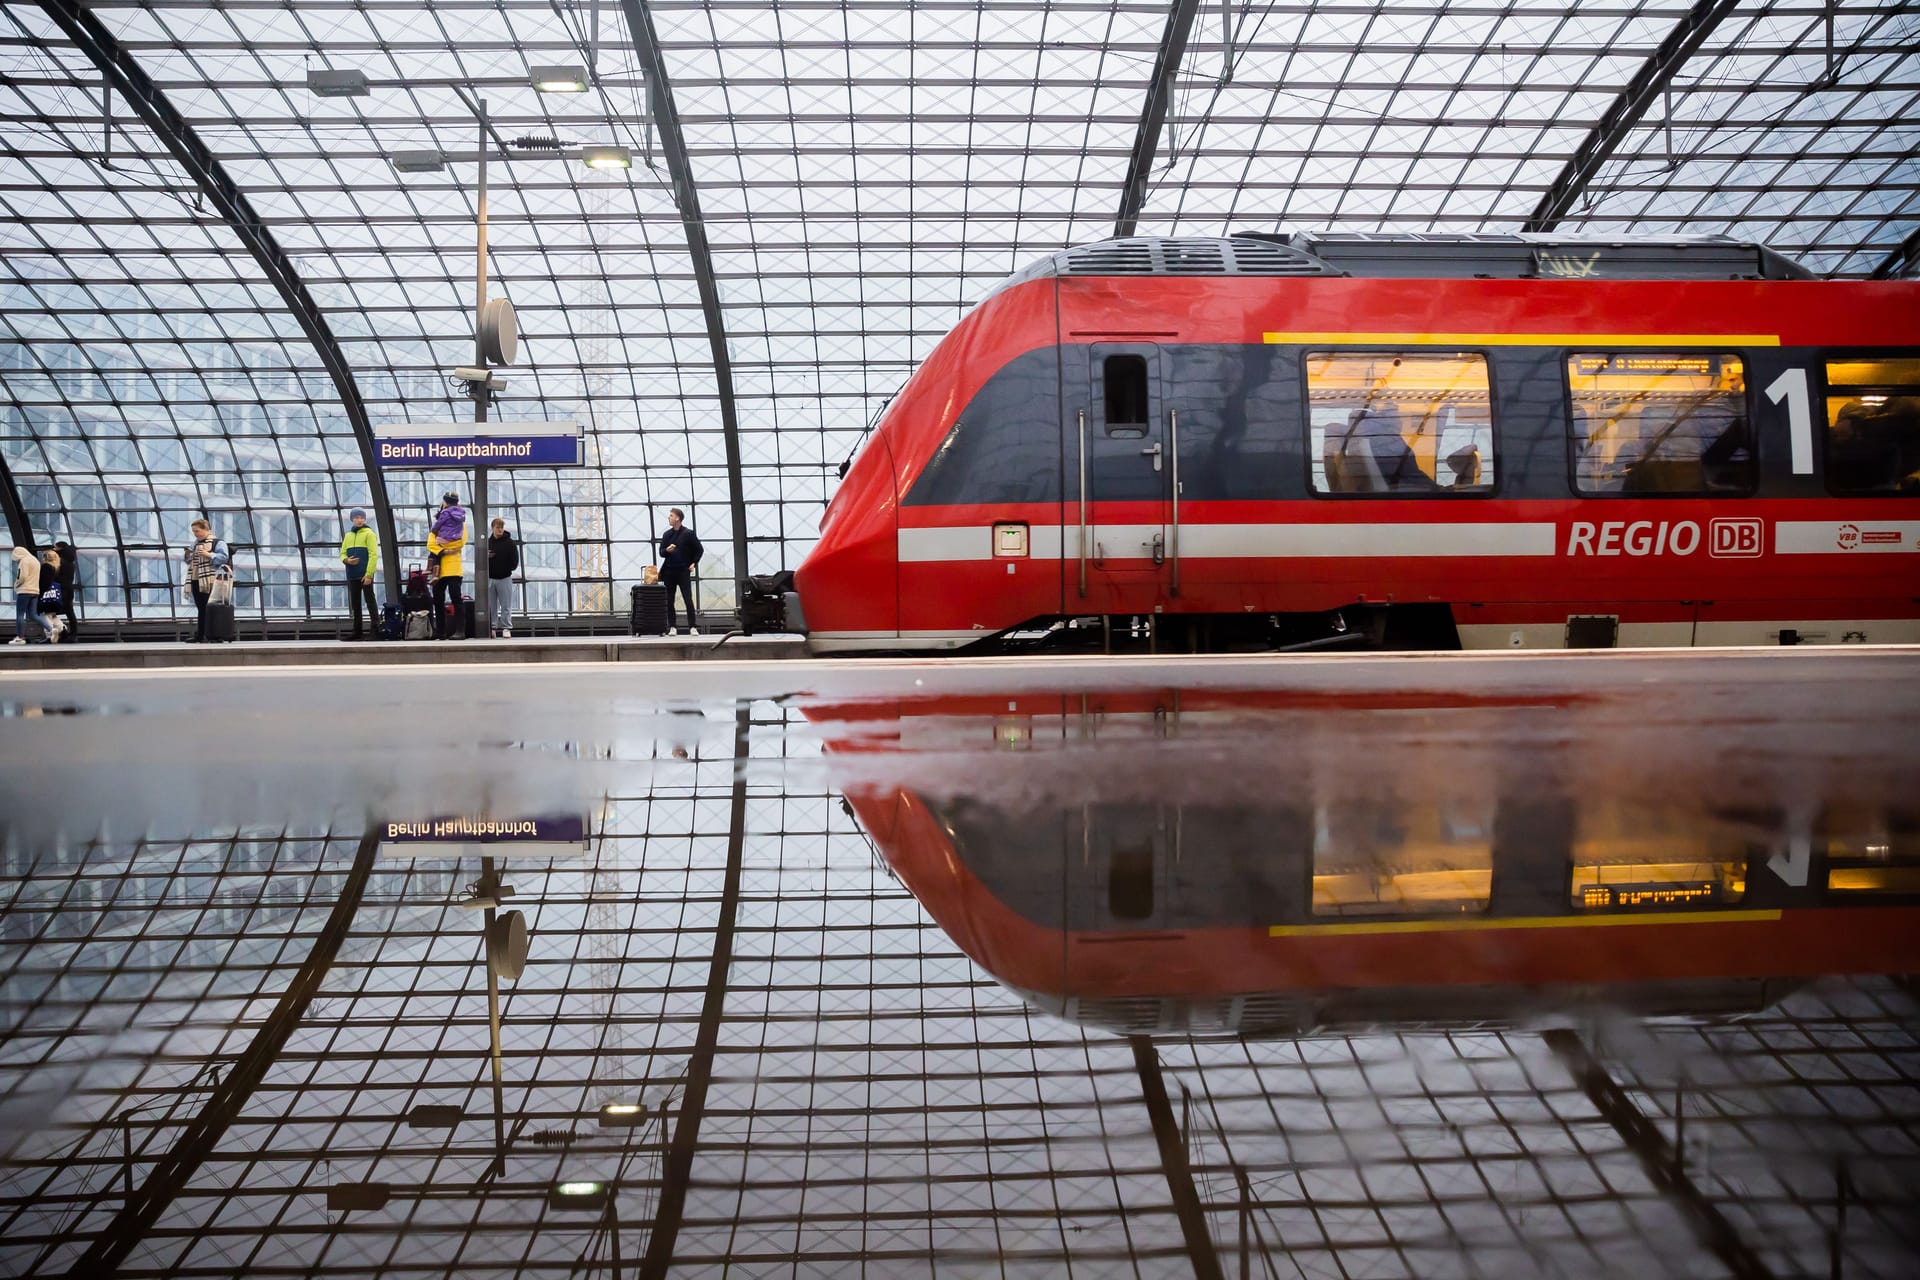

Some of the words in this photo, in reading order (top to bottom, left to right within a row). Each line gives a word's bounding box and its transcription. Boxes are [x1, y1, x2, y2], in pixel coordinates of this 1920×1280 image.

[1765, 368, 1814, 475] 1
[381, 443, 424, 458] Berlin
[428, 441, 532, 460] Hauptbahnhof
[1567, 520, 1701, 556] REGIO
[1716, 524, 1757, 552] DB
[1839, 533, 1857, 541] VBB
